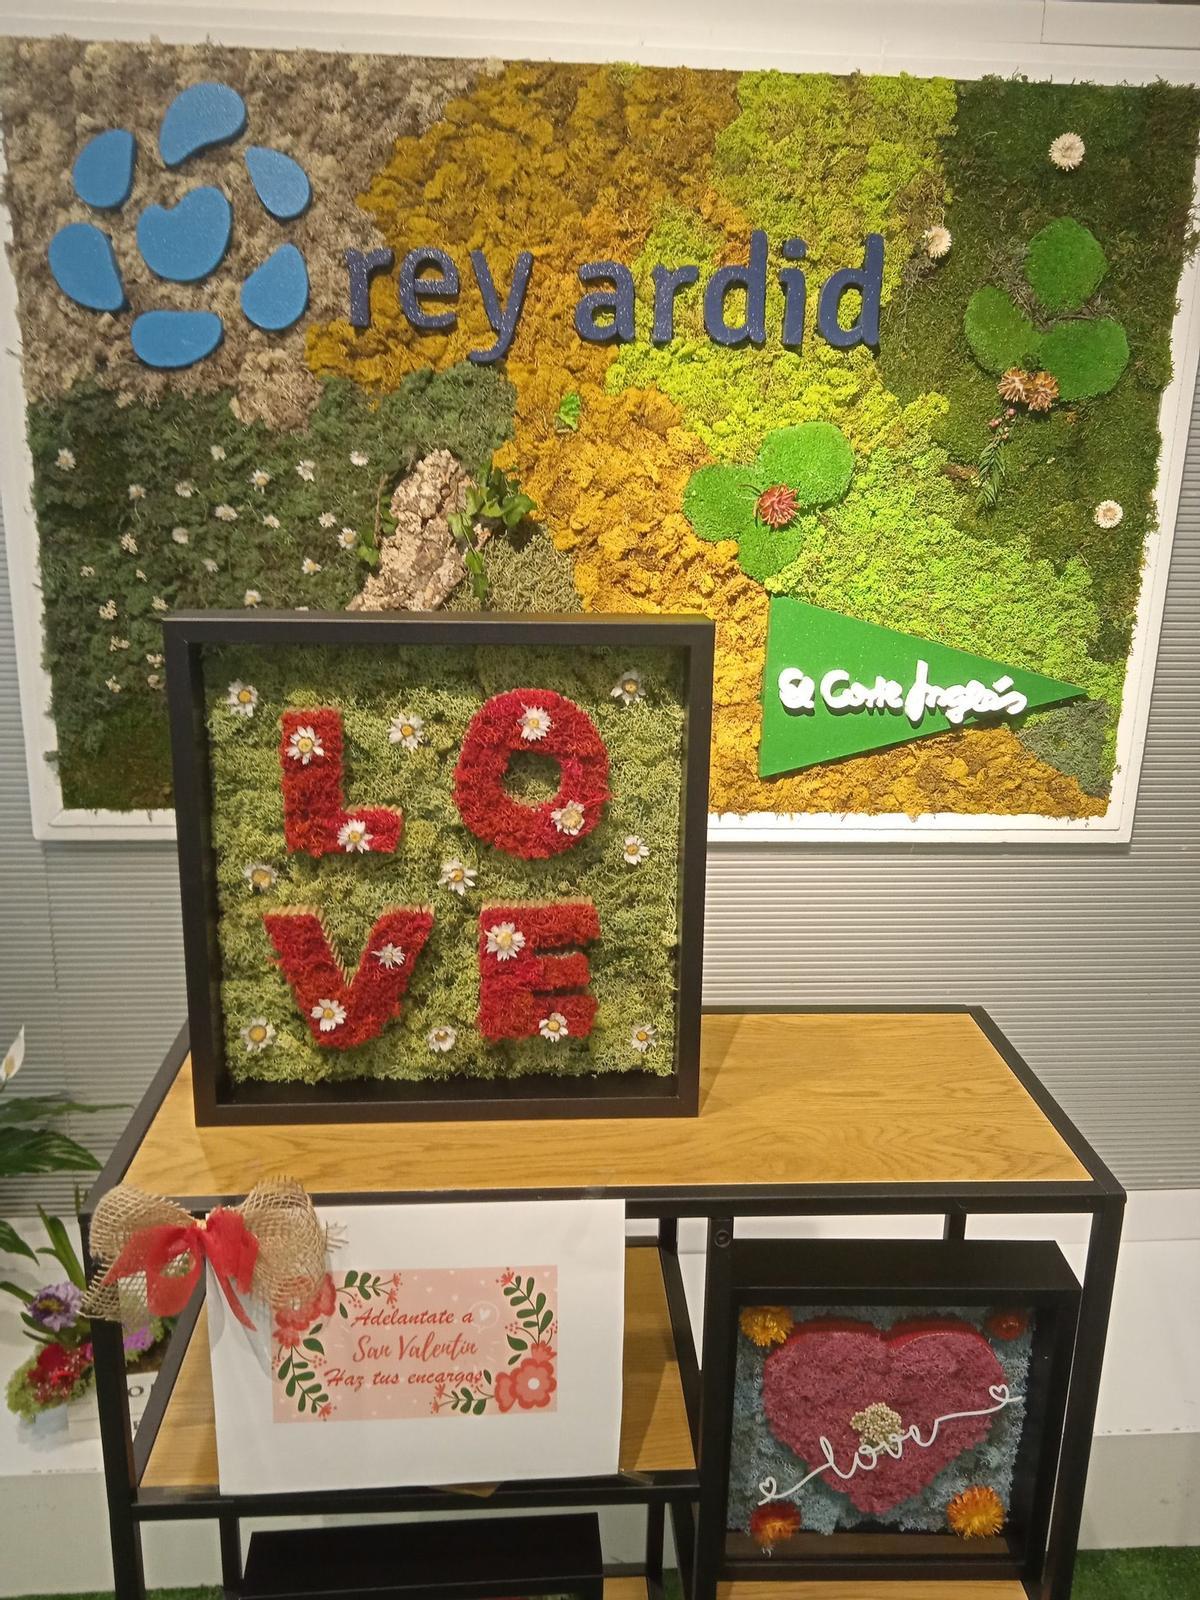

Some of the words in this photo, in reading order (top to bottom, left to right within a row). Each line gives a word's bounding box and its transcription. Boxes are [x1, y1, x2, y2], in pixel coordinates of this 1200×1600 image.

[344, 246, 535, 363] rey
[575, 229, 884, 348] ardid
[351, 1307, 455, 1328] Adelantate
[461, 1311, 473, 1324] a
[352, 1334, 392, 1363] San
[323, 1368, 365, 1391] Haz
[373, 1370, 400, 1384] tus
[407, 1369, 483, 1388] encargos
